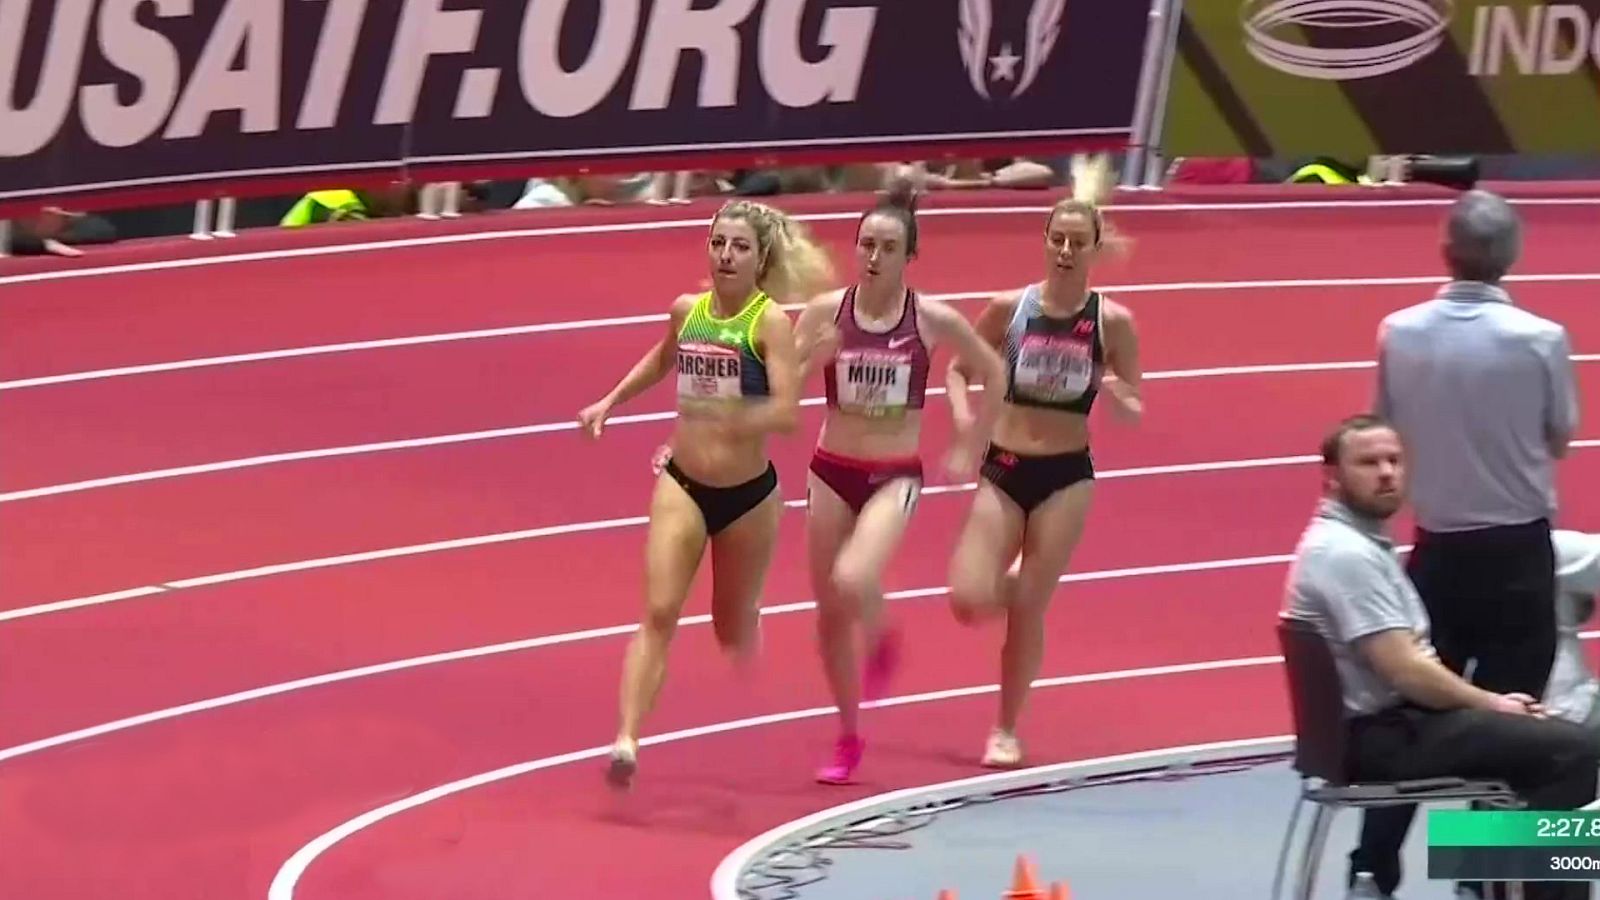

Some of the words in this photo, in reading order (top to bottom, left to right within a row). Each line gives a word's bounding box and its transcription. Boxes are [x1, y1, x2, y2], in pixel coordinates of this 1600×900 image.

[0, 0, 878, 157] USATF.ORG
[678, 353, 739, 377] ARCHER
[848, 364, 897, 386] MUIR
